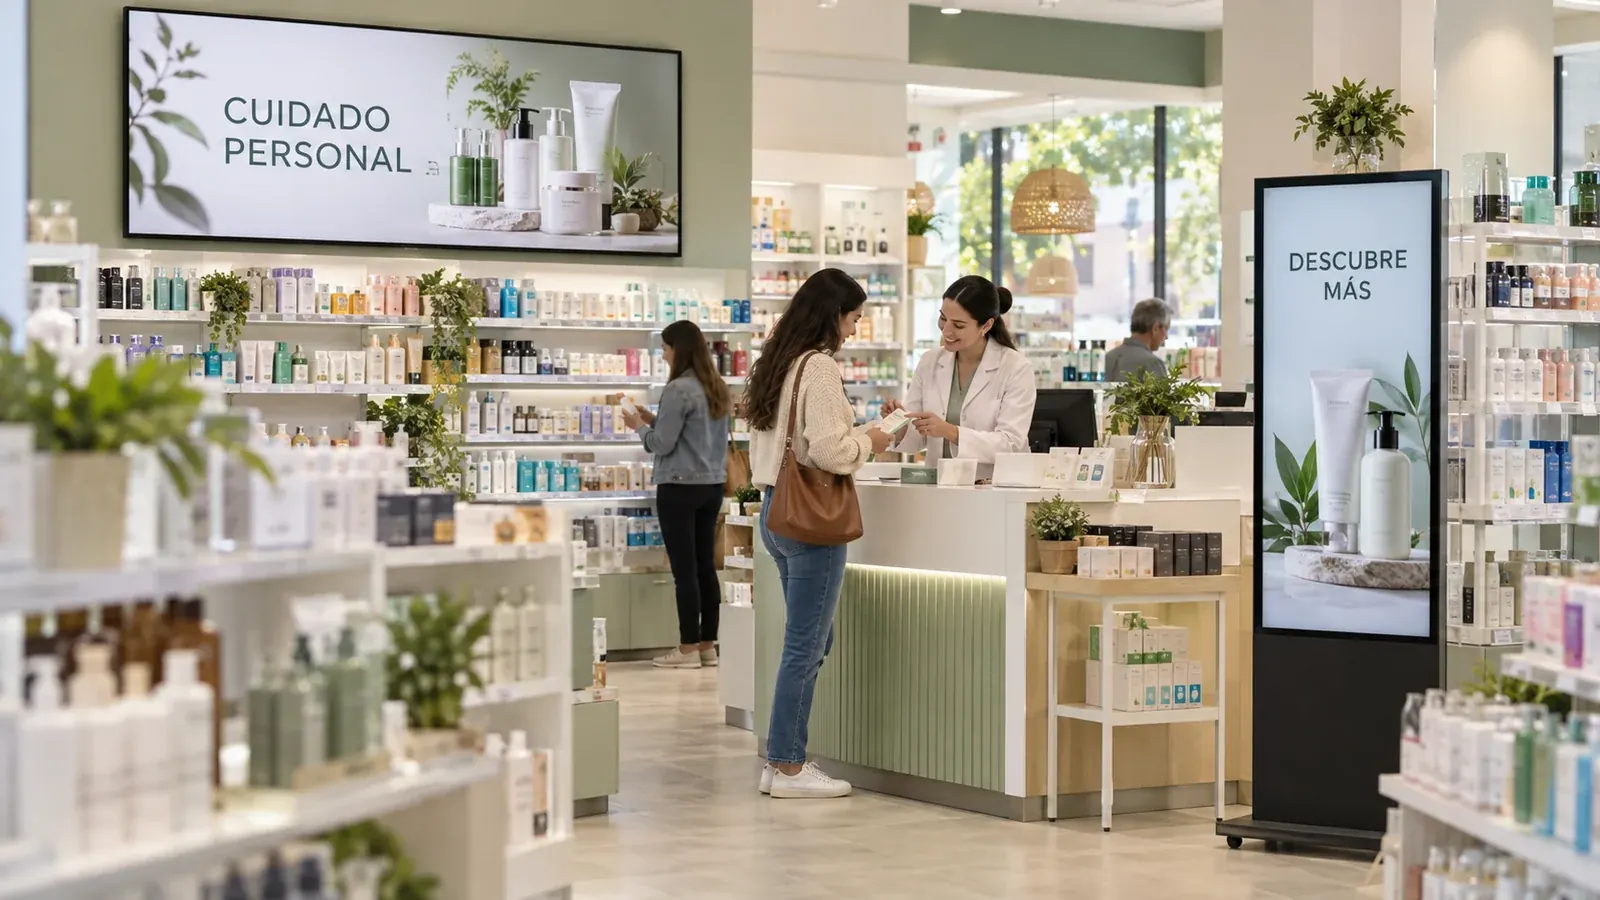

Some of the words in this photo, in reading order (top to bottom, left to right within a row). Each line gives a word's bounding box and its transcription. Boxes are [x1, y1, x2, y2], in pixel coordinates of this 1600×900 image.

[224, 96, 390, 132] CUIDADO
[225, 137, 412, 173] PERSONAL
[1290, 250, 1408, 272] DESCUBRE
[1325, 276, 1371, 301] MÁS
